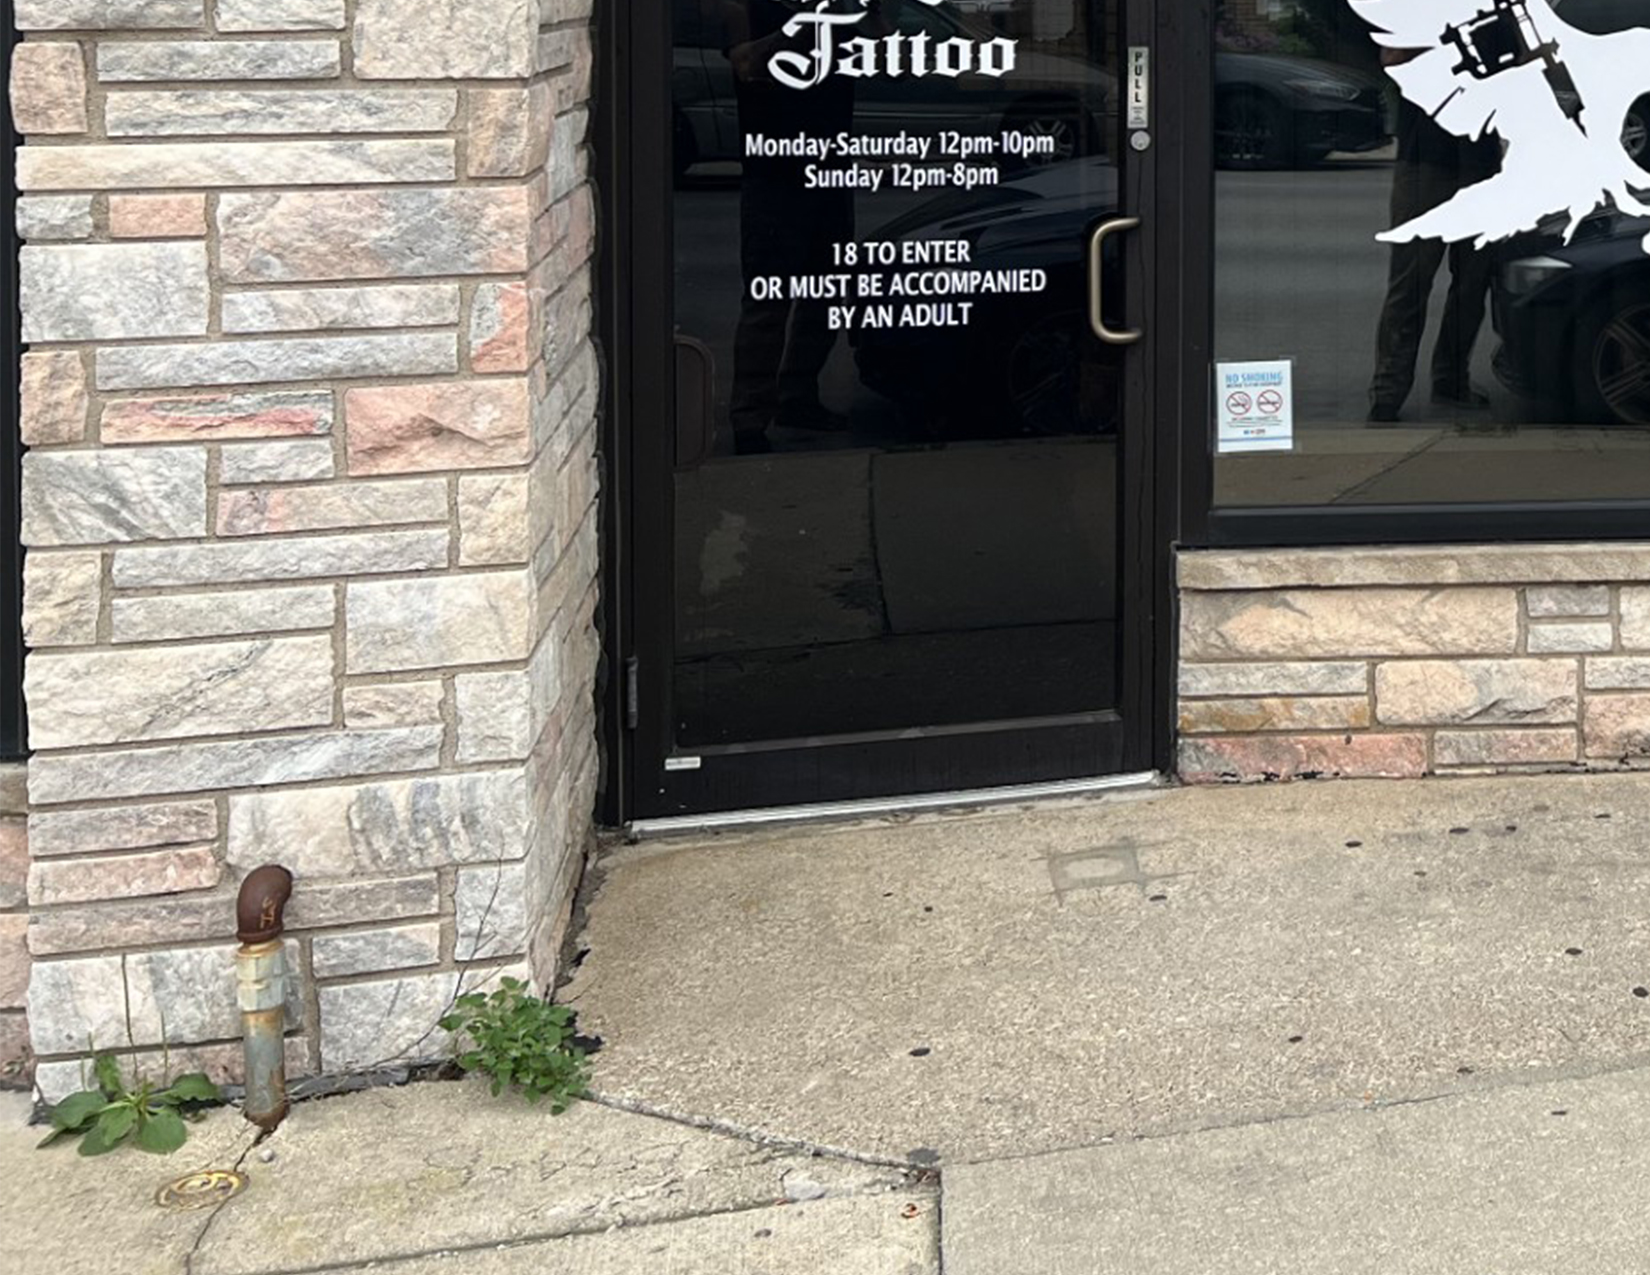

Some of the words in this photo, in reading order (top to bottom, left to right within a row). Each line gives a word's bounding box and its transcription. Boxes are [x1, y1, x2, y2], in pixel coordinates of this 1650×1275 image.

[767, 3, 1019, 90] Tattoo
[1134, 51, 1143, 103] PULL
[745, 130, 932, 161] Monday-Saturday
[939, 130, 1054, 159] 12pm-10pm
[804, 162, 884, 192] Sunday
[891, 162, 999, 192] 12pm-8pm
[832, 242, 858, 266] 18
[863, 241, 896, 265] TO
[902, 239, 971, 264] ENTER
[750, 276, 783, 300] OR
[790, 274, 852, 299] MUST
[857, 273, 884, 297] BE
[888, 269, 1047, 296] ACCOMPANIED
[828, 306, 856, 330] BY
[861, 304, 893, 328] AN
[899, 302, 973, 327] ADULT
[1225, 373, 1239, 383] NO
[1241, 371, 1283, 382] SMOKING
